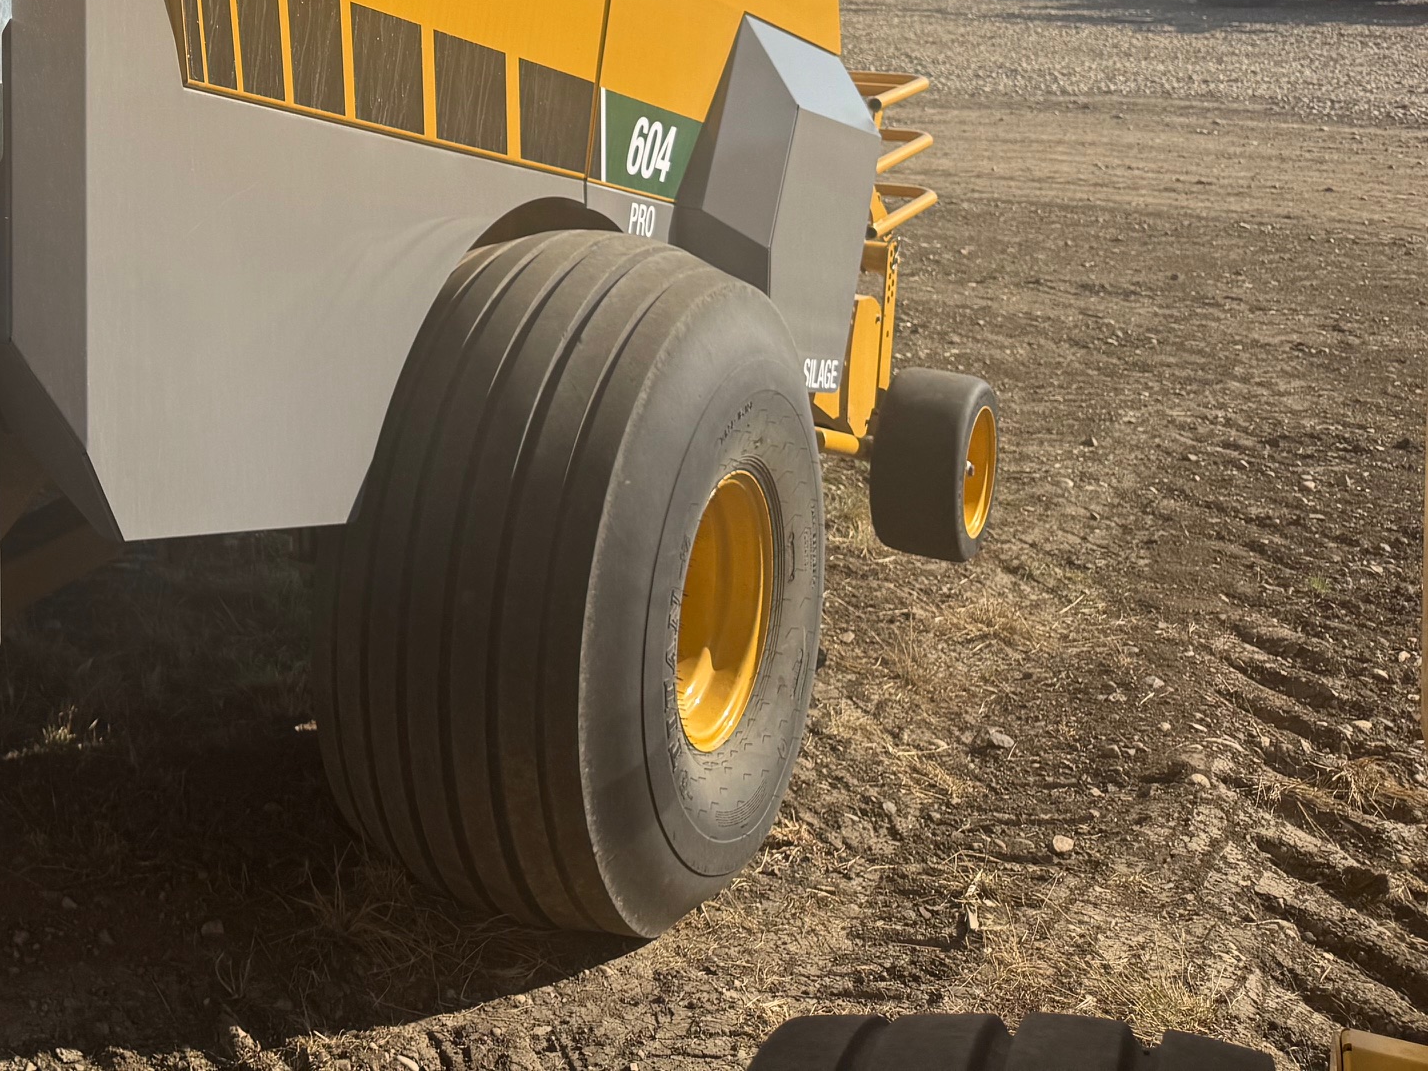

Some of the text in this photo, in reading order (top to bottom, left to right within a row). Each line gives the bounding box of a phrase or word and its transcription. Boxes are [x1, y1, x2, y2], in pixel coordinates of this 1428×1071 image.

[626, 116, 677, 183] 604
[628, 202, 656, 238] PRO
[803, 358, 839, 389] SILAGE
